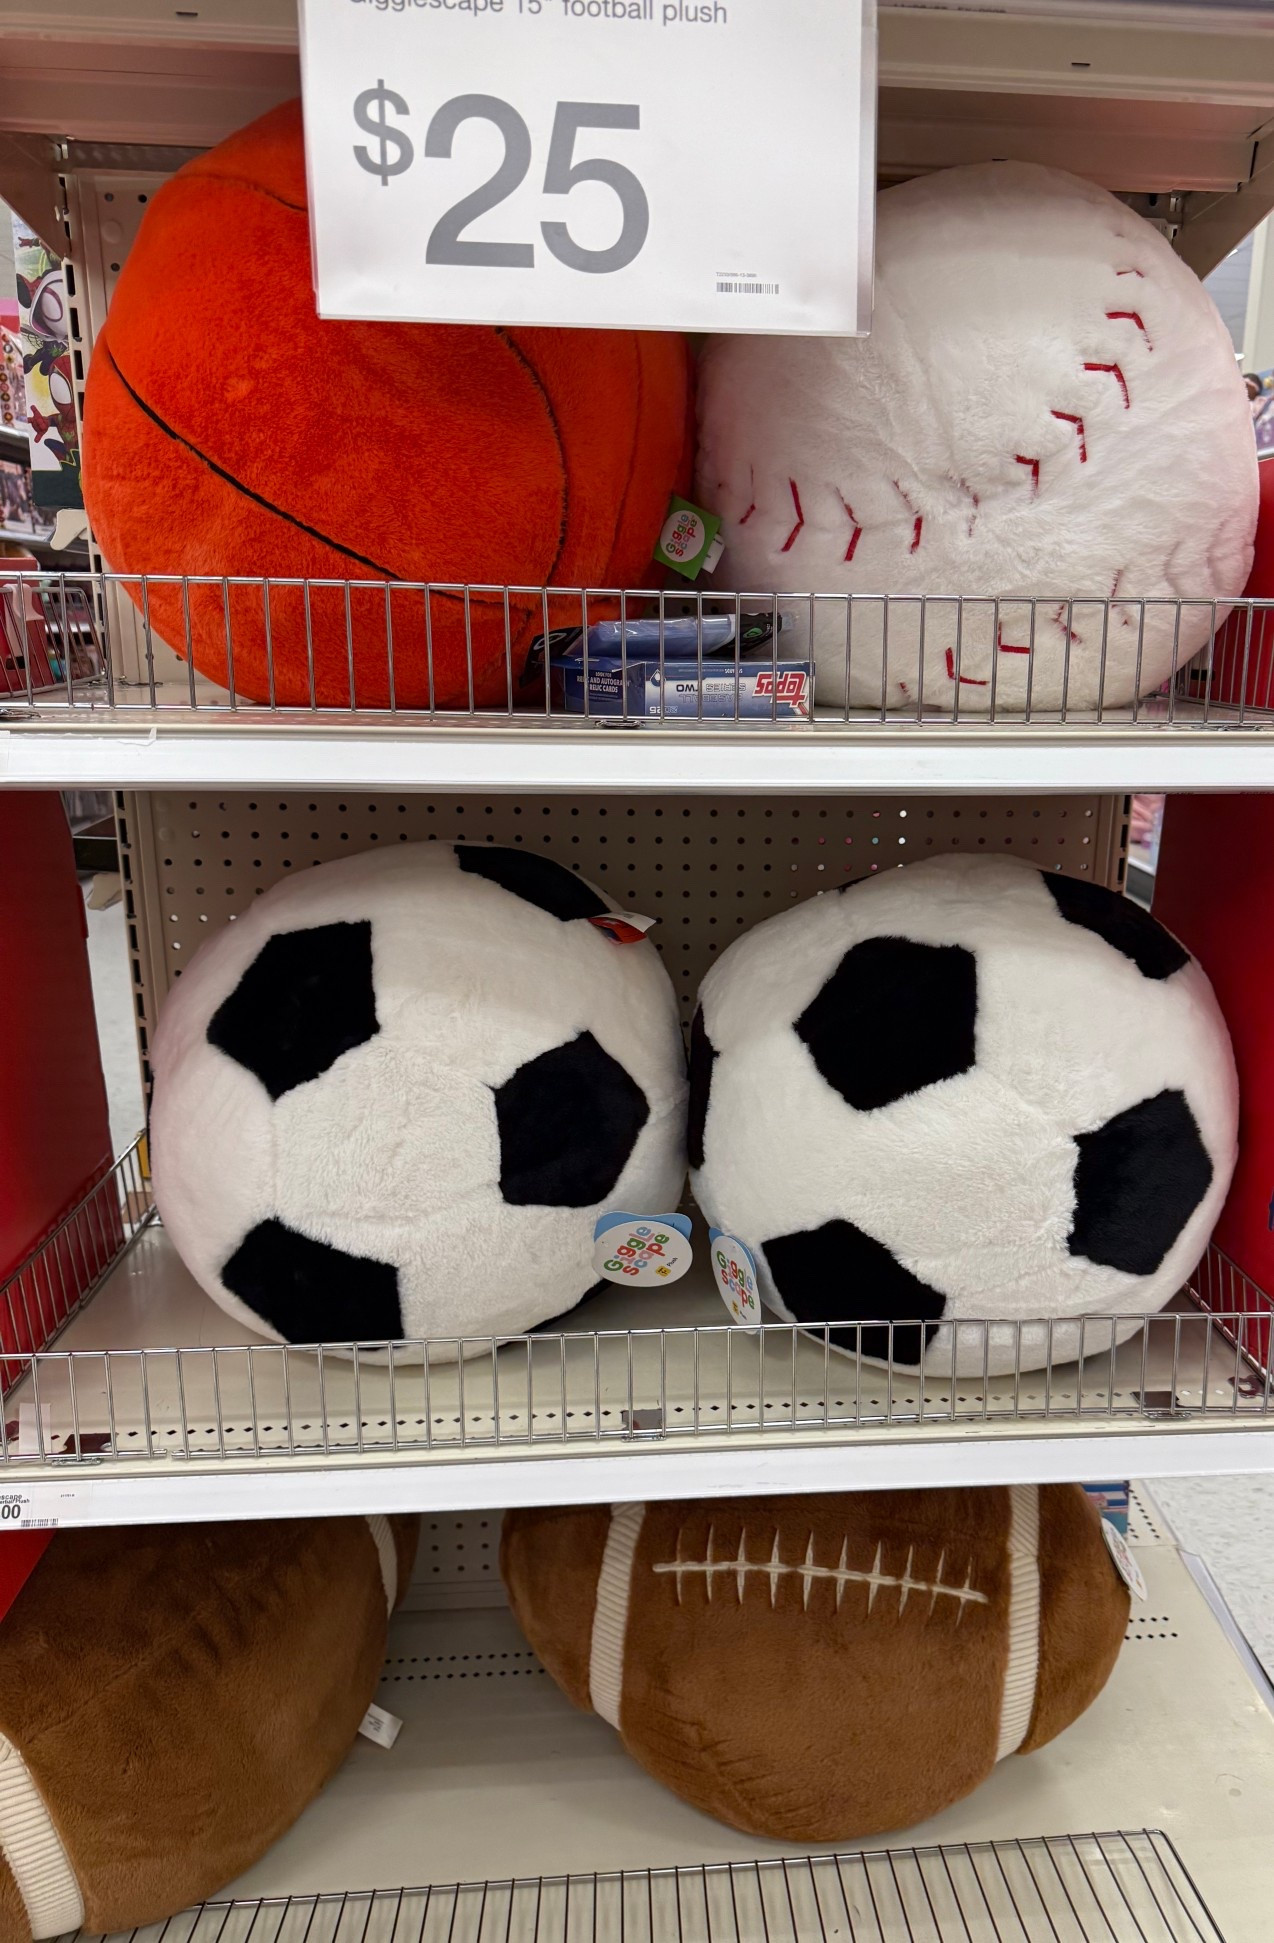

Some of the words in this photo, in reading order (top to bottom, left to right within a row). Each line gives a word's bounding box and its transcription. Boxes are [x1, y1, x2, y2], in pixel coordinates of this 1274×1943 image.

[351, 0, 504, 16] ggescape
[562, 0, 653, 20] football
[663, 0, 727, 26] plush
[353, 79, 650, 274] $25
[603, 685, 618, 693] CARDS
[604, 1226, 655, 1272] Giggle
[622, 1233, 670, 1276] scape
[716, 1250, 754, 1295] Giggle
[721, 1268, 755, 1310] scape
